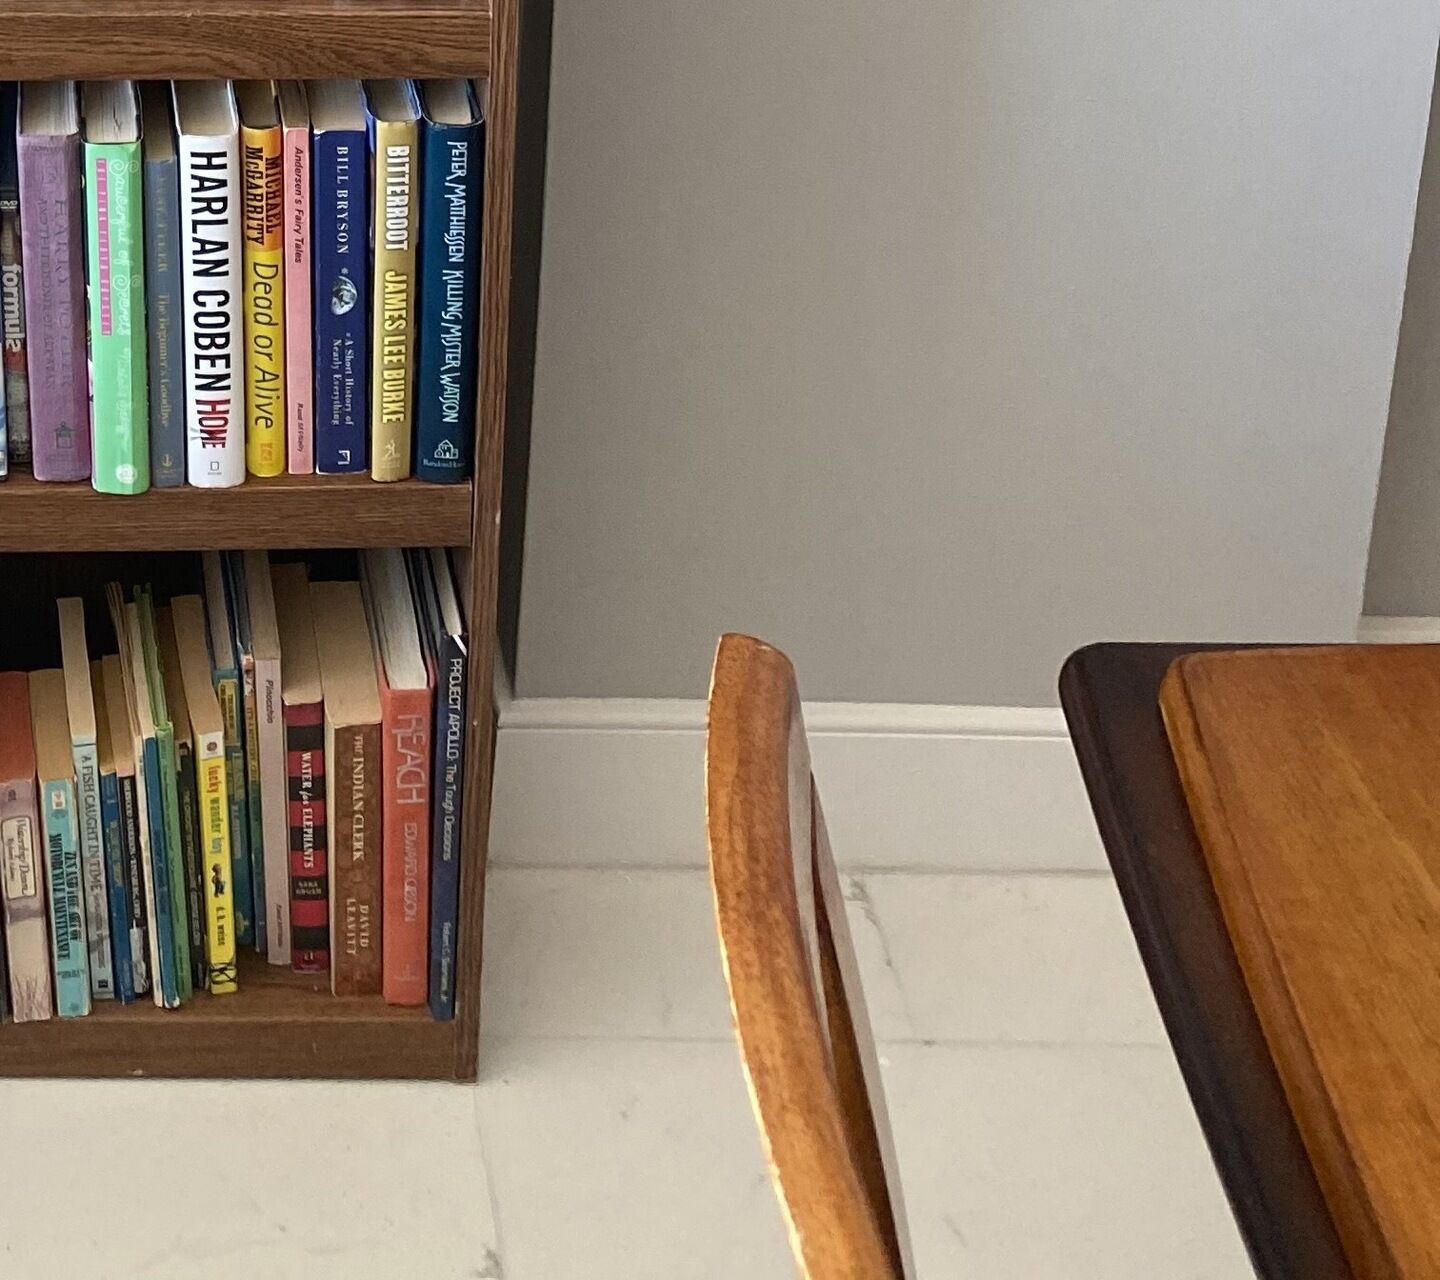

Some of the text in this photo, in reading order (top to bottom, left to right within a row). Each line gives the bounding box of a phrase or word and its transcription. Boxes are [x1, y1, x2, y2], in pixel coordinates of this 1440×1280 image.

[264, 157, 282, 233] MICHAEL
[292, 147, 305, 263] Andersen's Fairy Tales
[336, 146, 349, 254] BILL BRYSON
[385, 146, 410, 251] BITTERROOT
[190, 151, 232, 449] HARLAN COBEN HOME
[439, 142, 468, 423] PETER MATTHIESSEN KILLING MISTER WATSON
[251, 262, 280, 429] Dead or Alive
[382, 270, 407, 424] JAMES LEE BURKE
[265, 679, 275, 724] Pinocchio
[391, 714, 425, 803] REACH
[442, 659, 462, 861] PROJECT APOLLO: The Tough Decisions
